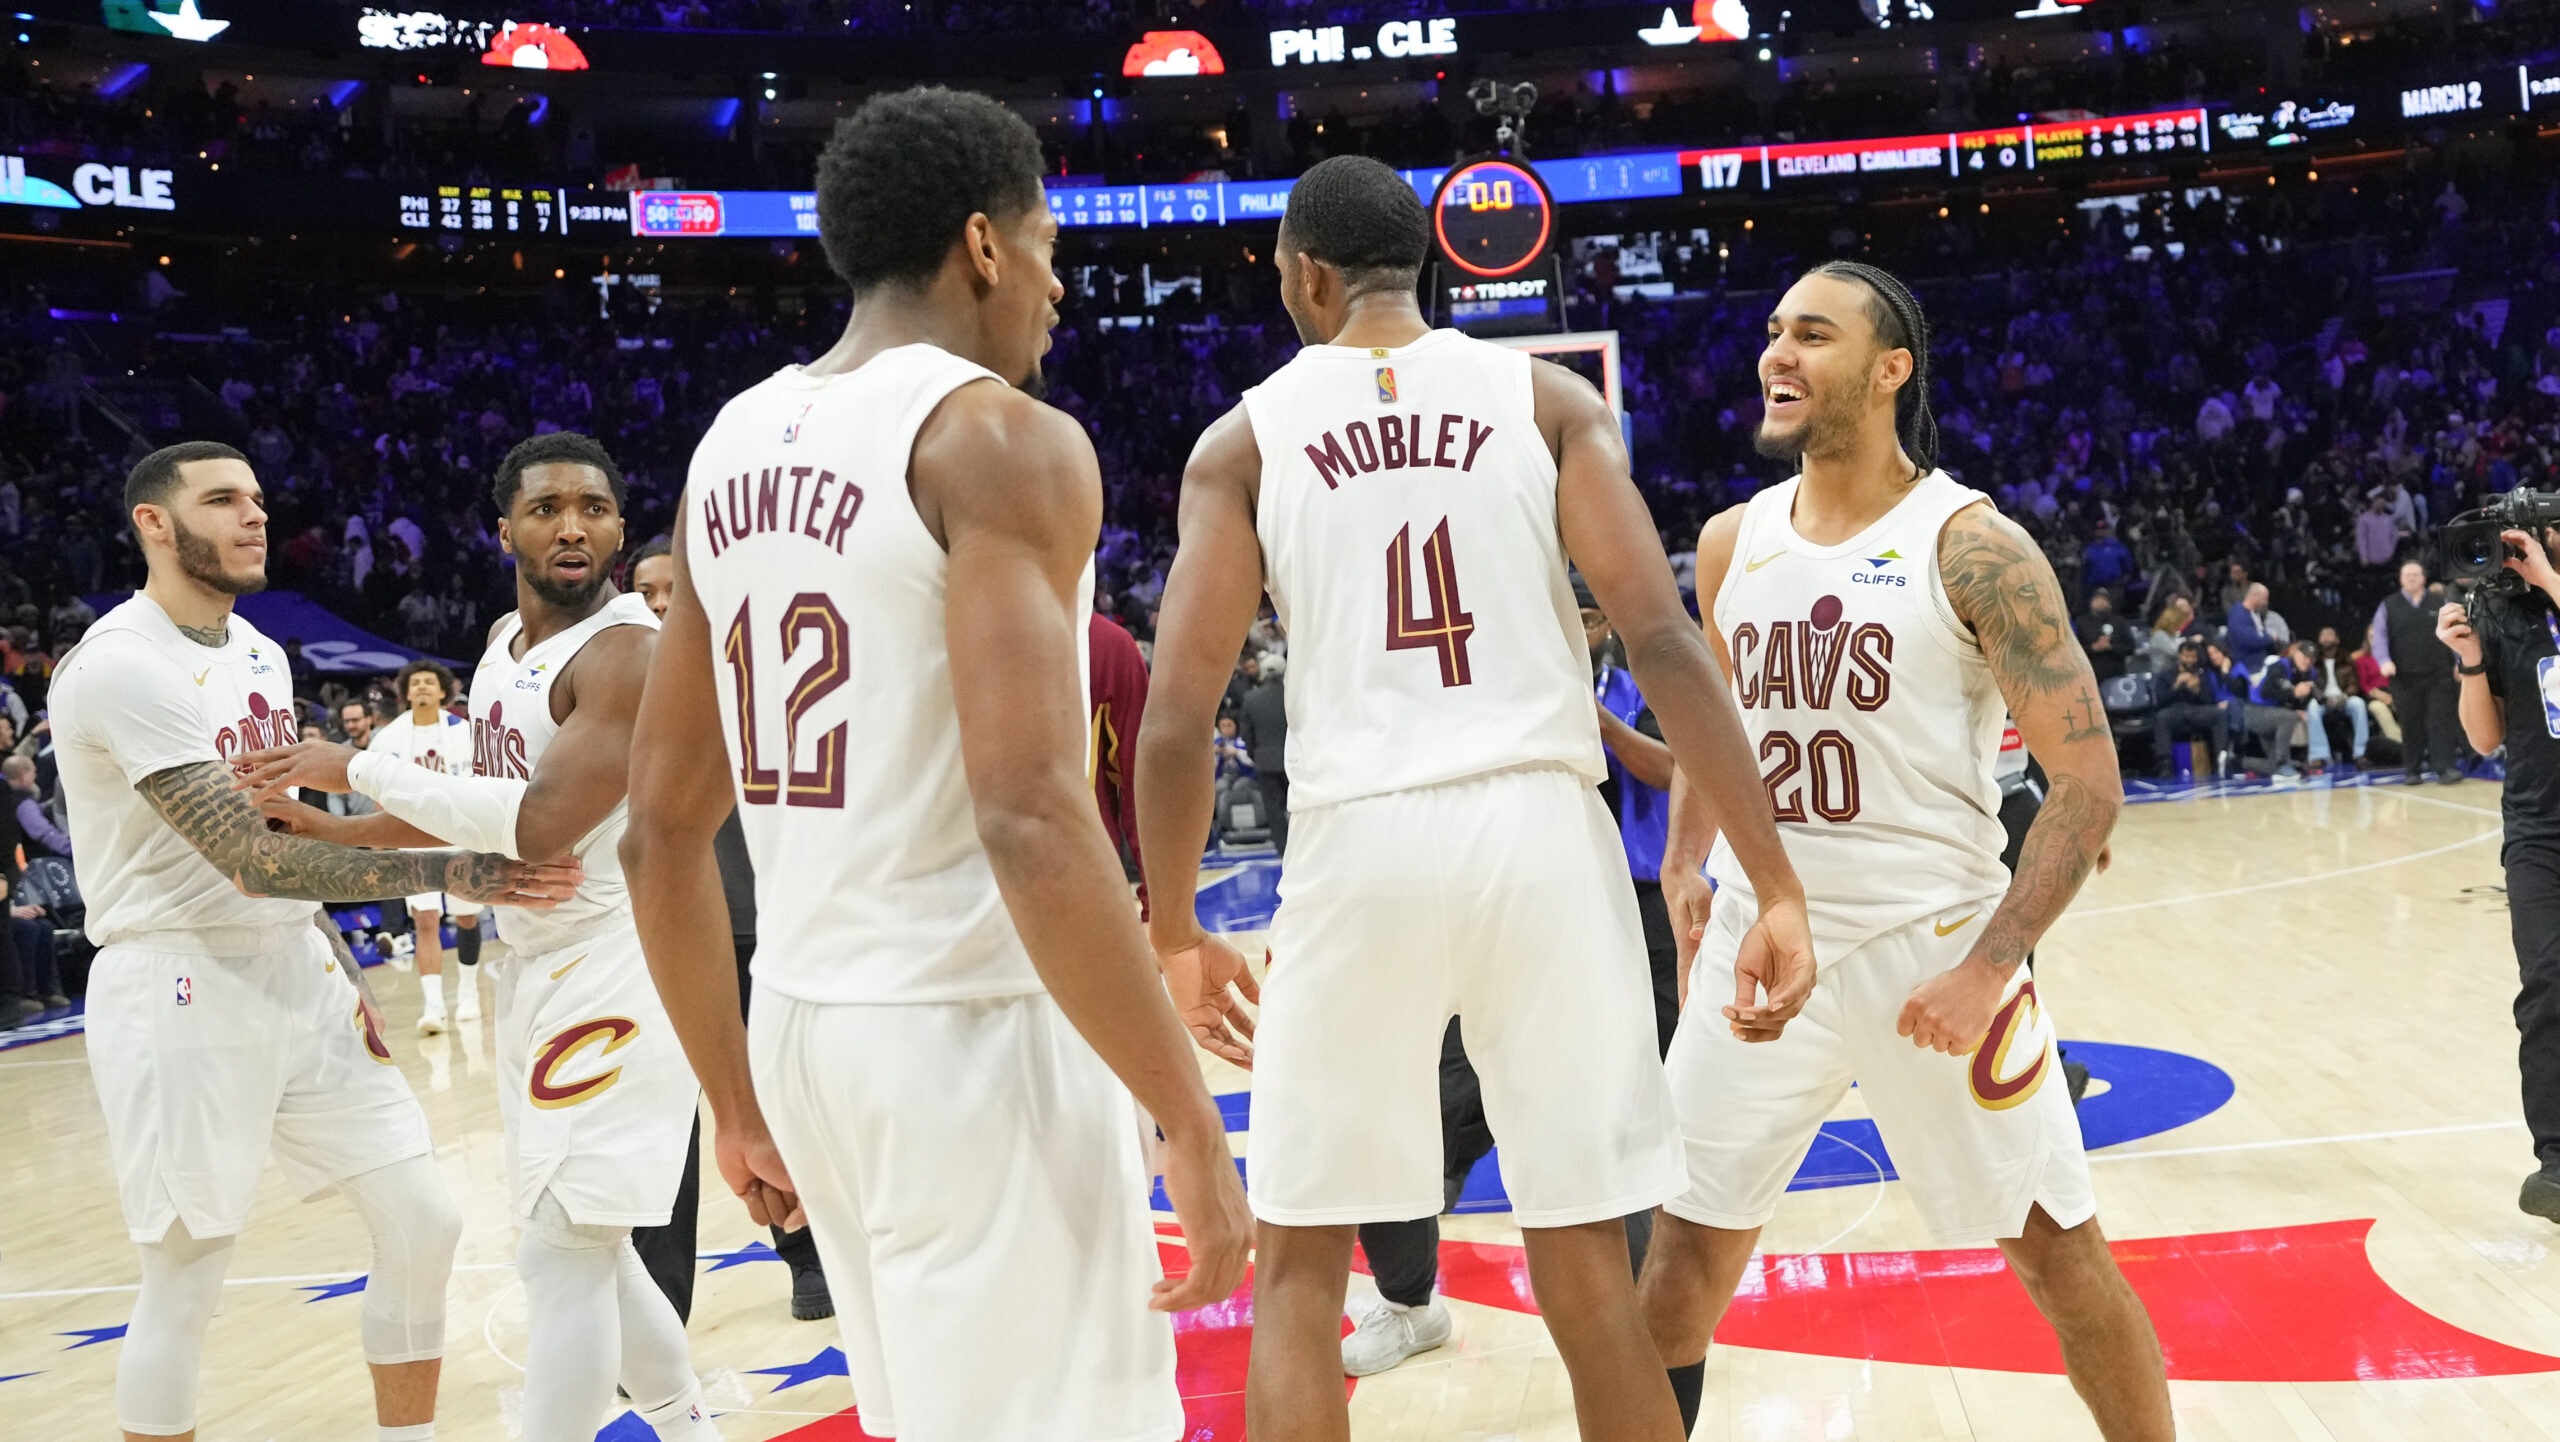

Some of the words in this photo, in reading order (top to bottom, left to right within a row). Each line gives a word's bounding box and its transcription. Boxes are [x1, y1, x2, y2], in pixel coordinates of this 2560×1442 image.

[1269, 26, 1344, 67] PHI
[1377, 18, 1457, 58] CLE
[2401, 82, 2466, 118] MARCH
[2467, 81, 2481, 109] 2
[2034, 128, 2083, 145] PLAYER
[1777, 153, 1856, 177] CLEVELAND
[1859, 147, 1941, 171] CAVALIERS
[1968, 151, 1985, 169] 4
[1999, 147, 2016, 167] 0
[2037, 144, 2083, 161] POINTS
[1699, 153, 1742, 188] 117
[72, 162, 175, 210] CLE
[1118, 193, 1135, 207] 77
[1470, 181, 1513, 212] 0.0
[400, 195, 429, 211] PHI
[440, 198, 460, 213] 37
[603, 207, 629, 221] PM
[647, 206, 669, 223] 50
[692, 205, 715, 223] 50
[1160, 205, 1174, 223] 4
[1190, 203, 1207, 222] 0
[400, 212, 430, 228] CLE
[441, 214, 463, 229] 42
[538, 218, 549, 232] 7
[1304, 414, 1494, 491] MOBLEY
[704, 466, 864, 557] HUNTER
[1852, 572, 1906, 587] CLIFFS
[1386, 514, 1475, 687] 4
[1733, 620, 1893, 712] CAVS
[515, 679, 541, 692] CLIFFS
[725, 593, 850, 808] 12
[1759, 729, 1861, 823] 20
[528, 1015, 640, 1110] C
